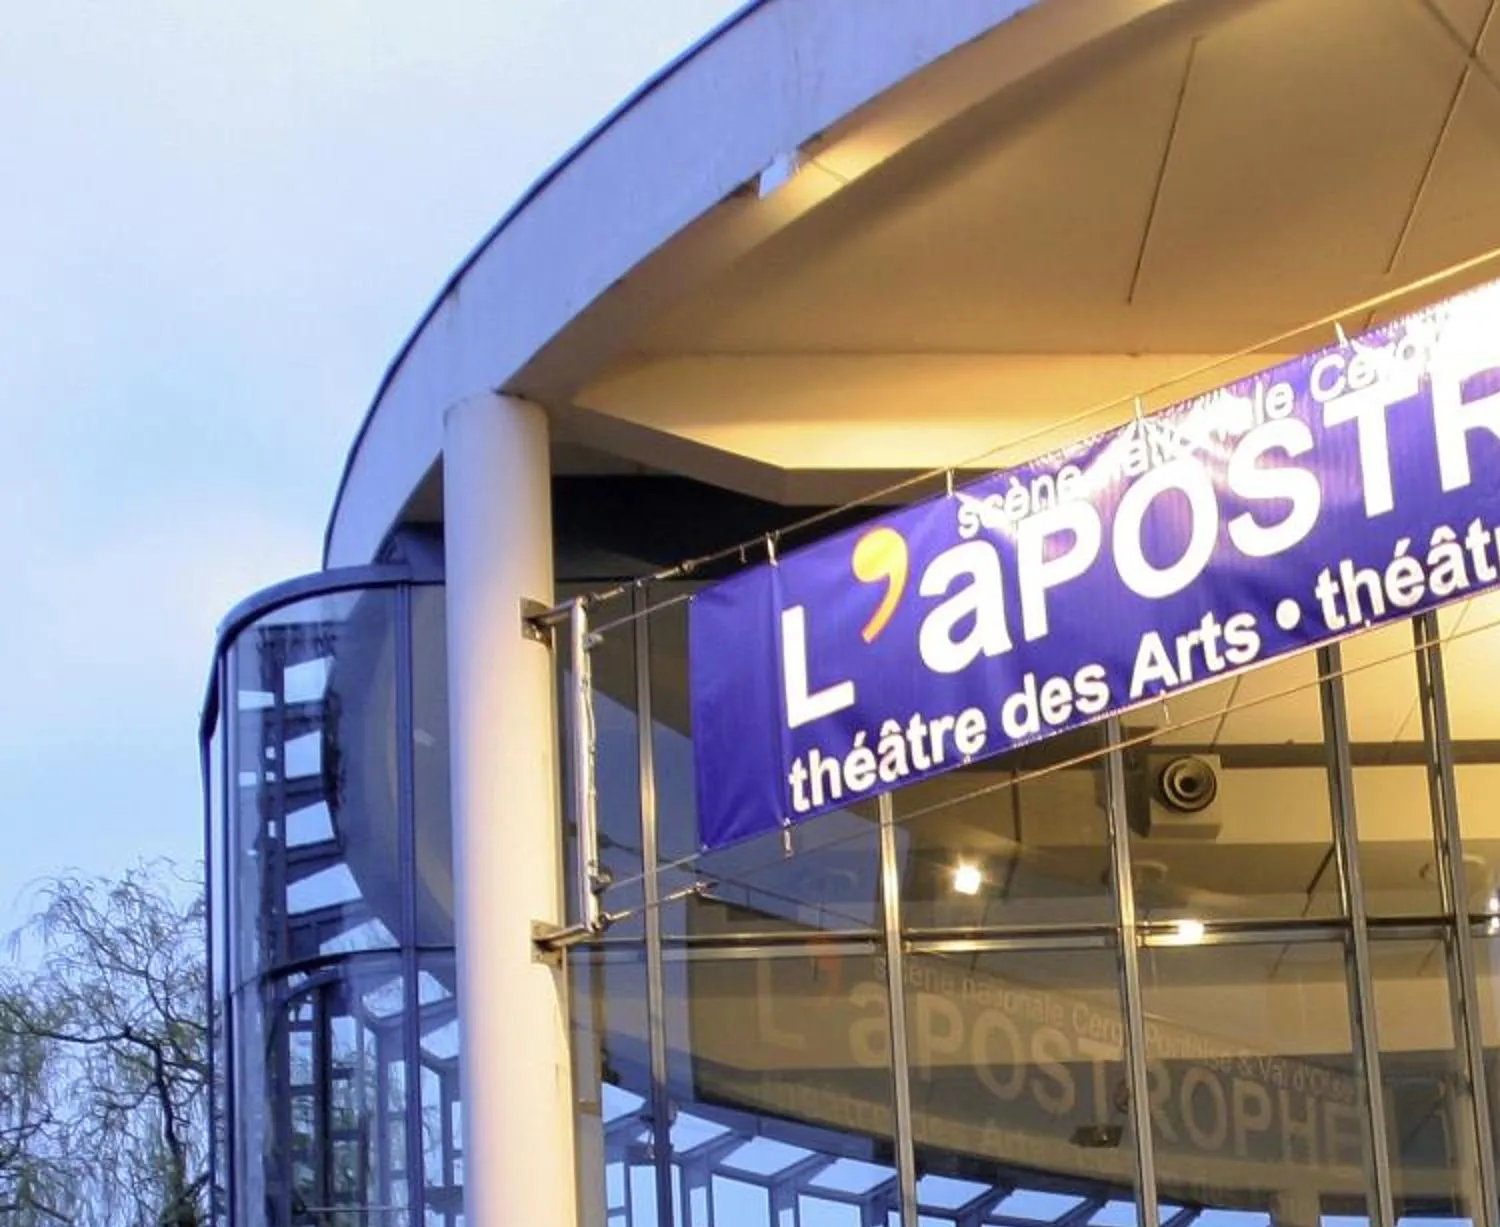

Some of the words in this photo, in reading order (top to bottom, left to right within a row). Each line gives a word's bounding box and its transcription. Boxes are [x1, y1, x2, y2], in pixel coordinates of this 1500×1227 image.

[788, 713, 987, 812] théâtre
[1001, 663, 1110, 739] des
[1129, 610, 1261, 698] Arts
